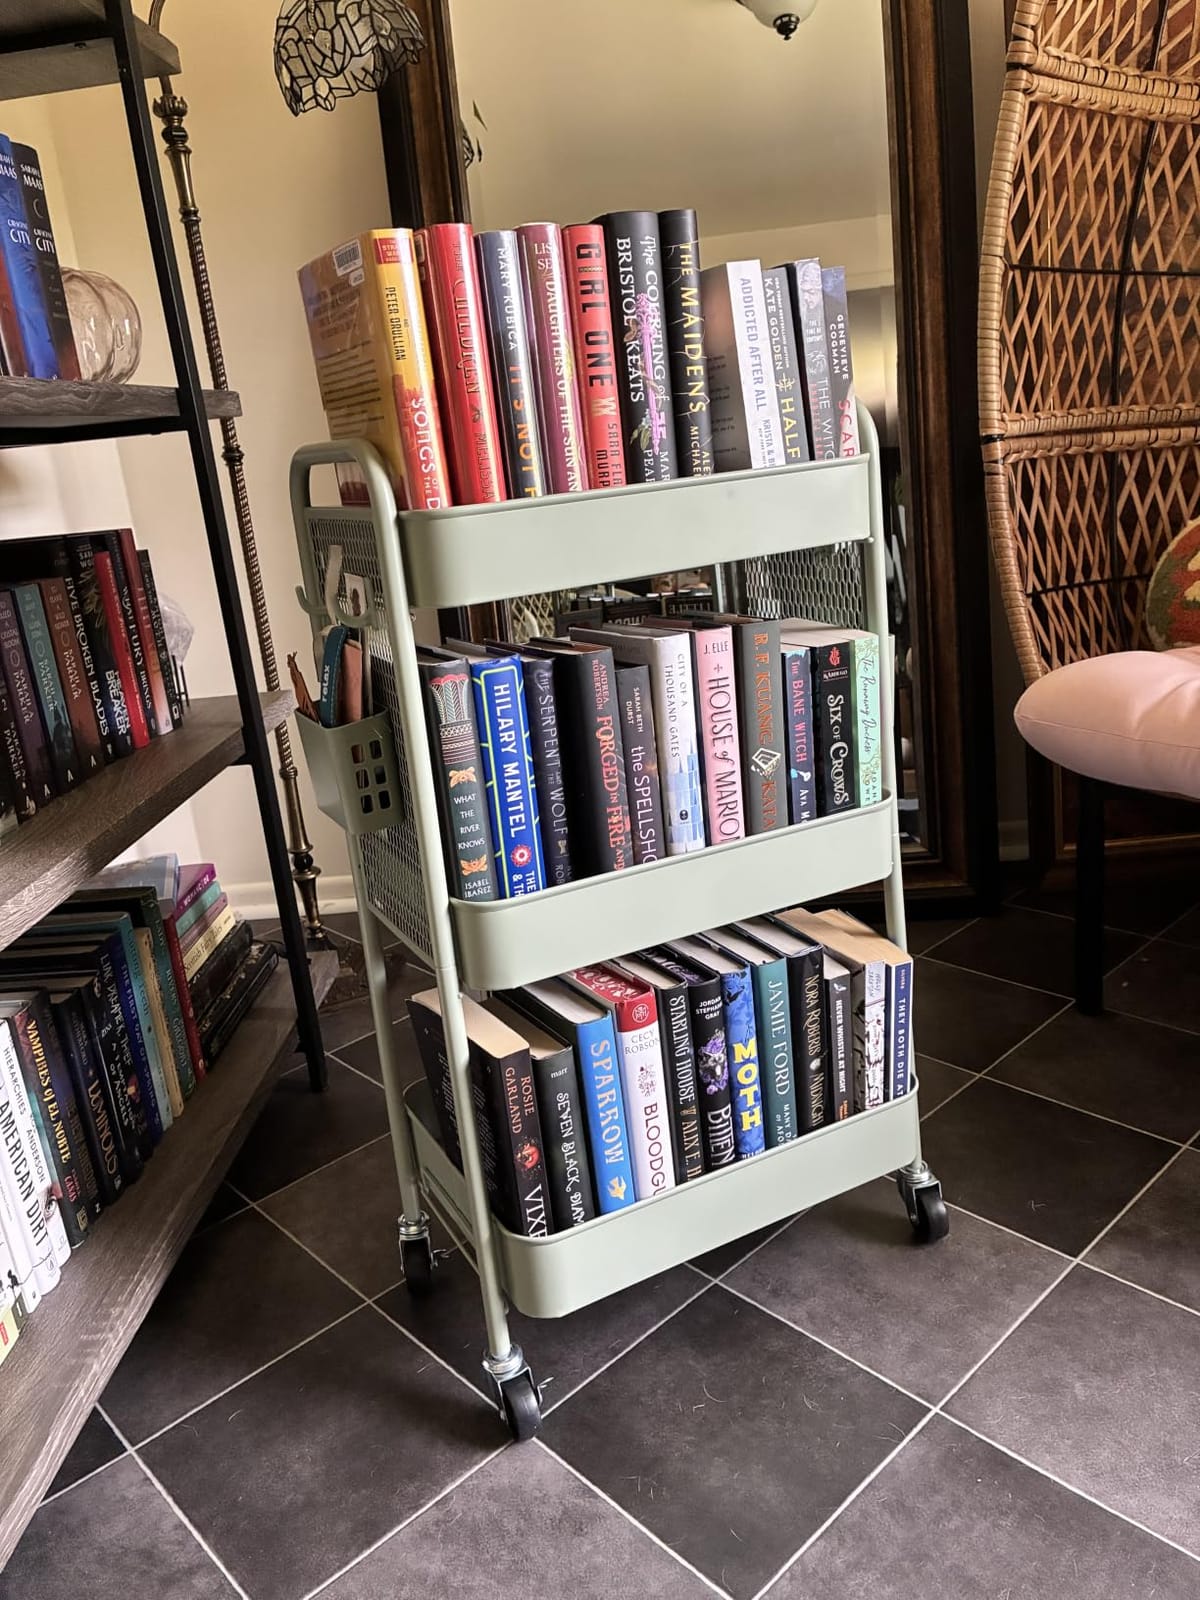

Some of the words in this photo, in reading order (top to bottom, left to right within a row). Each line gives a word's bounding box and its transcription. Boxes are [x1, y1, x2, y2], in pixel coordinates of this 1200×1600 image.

[23, 174, 43, 190] MAAS
[10, 228, 31, 245] CITY
[35, 237, 55, 254] CITY
[641, 235, 656, 265] The
[497, 247, 512, 288] MARY
[575, 243, 606, 314] GIRL
[679, 243, 693, 276] THE
[385, 286, 397, 318] PETER
[617, 237, 636, 326] BRISTOL
[764, 278, 776, 313] KATE
[503, 295, 518, 351] KUBICA
[546, 282, 564, 377] DAUGHTERS
[646, 269, 665, 382] COURTING
[740, 278, 759, 344] ADDICTED
[585, 331, 614, 388] ONE
[680, 286, 706, 413] MAIDENS
[769, 317, 783, 368] GOLDEN
[830, 323, 840, 374] COGMAN
[837, 314, 848, 381] GENEVIEVE
[625, 340, 645, 402] KEATS
[749, 345, 764, 386] AFTER
[754, 388, 767, 411] ALL
[817, 377, 830, 410] THE
[411, 398, 437, 473] SONGS
[516, 422, 537, 475] NOT
[607, 423, 619, 461] SARA
[764, 419, 773, 449] KRISTA
[781, 397, 800, 459] HALF
[472, 431, 497, 501] MELISSA
[65, 577, 79, 610] FIVE
[75, 611, 94, 676] BROKEN
[90, 680, 109, 737] BLADES
[704, 643, 710, 655] J.
[712, 641, 729, 653] ELLE
[753, 632, 769, 650] R.
[755, 653, 769, 668] F.
[105, 670, 127, 735] BREAKER
[139, 670, 152, 709] BRINGS
[592, 659, 604, 710] ROBERTSON
[600, 664, 610, 704] ANDREA
[633, 687, 641, 713] SARAH
[665, 664, 677, 725] THOUSAND
[680, 681, 686, 694] OF
[792, 679, 805, 716] BANE
[494, 683, 517, 754] HILARY
[626, 700, 634, 725] DURST
[708, 676, 734, 747] HOUSE
[755, 672, 773, 745] KUANG
[827, 694, 844, 729] SIX
[539, 695, 561, 768] SERPENT
[670, 727, 680, 758] GATES
[794, 720, 808, 763] WITCH
[832, 727, 841, 739] OF
[861, 717, 877, 753] Duchess
[5, 729, 20, 779] PARKER
[597, 715, 620, 794] FORGED
[631, 746, 643, 772] the
[715, 750, 734, 766] of
[830, 741, 849, 805] CROWS
[453, 793, 477, 805] WHAT
[460, 810, 475, 818] THE
[503, 762, 526, 838] MANTEL
[549, 787, 568, 835] WOLF
[457, 838, 485, 850] KNOWS
[460, 824, 481, 834] RIVER
[607, 805, 626, 849] FIRE
[464, 879, 489, 890] ISABEL
[525, 870, 537, 892] THE
[699, 996, 721, 1009] JORDAN
[768, 980, 785, 1039] JAMIE
[805, 974, 819, 1008] NORA
[631, 1029, 655, 1044] CECY
[669, 995, 689, 1058] STARLING
[705, 1011, 720, 1020] GRAY
[803, 1008, 824, 1057] ROBERTS
[898, 1022, 906, 1051] BOTH
[27, 1020, 51, 1087] VAMPIRES
[624, 1038, 660, 1055] ROBSON
[897, 1057, 905, 1076] DIE
[3, 1046, 26, 1116] HIERARCHIES
[551, 1068, 569, 1079] marr
[675, 1058, 695, 1105] HOUSE
[733, 1040, 762, 1132] MOTH
[772, 1041, 791, 1095] FORD
[44, 1088, 55, 1102] of
[48, 1101, 59, 1120] EL
[505, 1067, 523, 1134] GARLAND
[521, 1075, 535, 1116] ROSIE
[556, 1092, 574, 1138] SEVEN
[590, 1039, 625, 1165] SPARROW
[54, 1122, 72, 1164] NORTE
[87, 1080, 118, 1175] LUMINOUS
[681, 1120, 699, 1152] ALIX
[707, 1103, 735, 1166] BITTEN
[0, 1099, 35, 1203] AMERICAN
[26, 1199, 48, 1246] DIRT
[26, 1129, 46, 1183] ANDERSON
[561, 1141, 580, 1193] BLACK
[685, 1152, 698, 1167] E.
